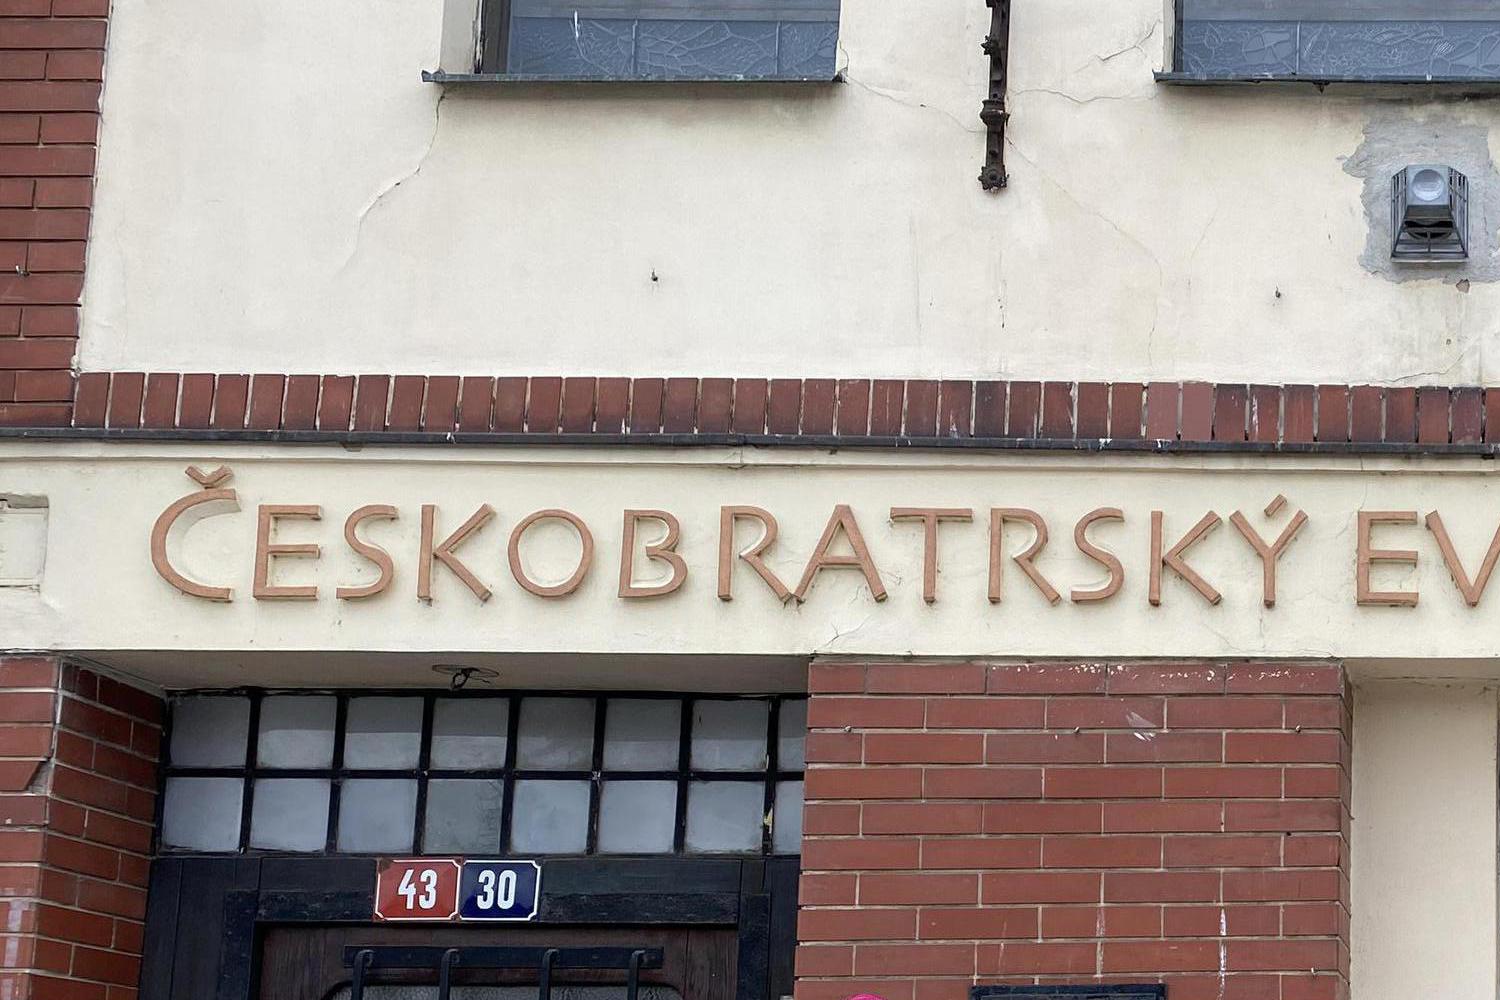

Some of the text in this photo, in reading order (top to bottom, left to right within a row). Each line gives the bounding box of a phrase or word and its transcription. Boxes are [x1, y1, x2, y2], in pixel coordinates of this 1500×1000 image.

[150, 464, 1310, 608] ČESKOBRATRSKÝ
[397, 869, 438, 910] 43
[476, 869, 517, 910] 30
